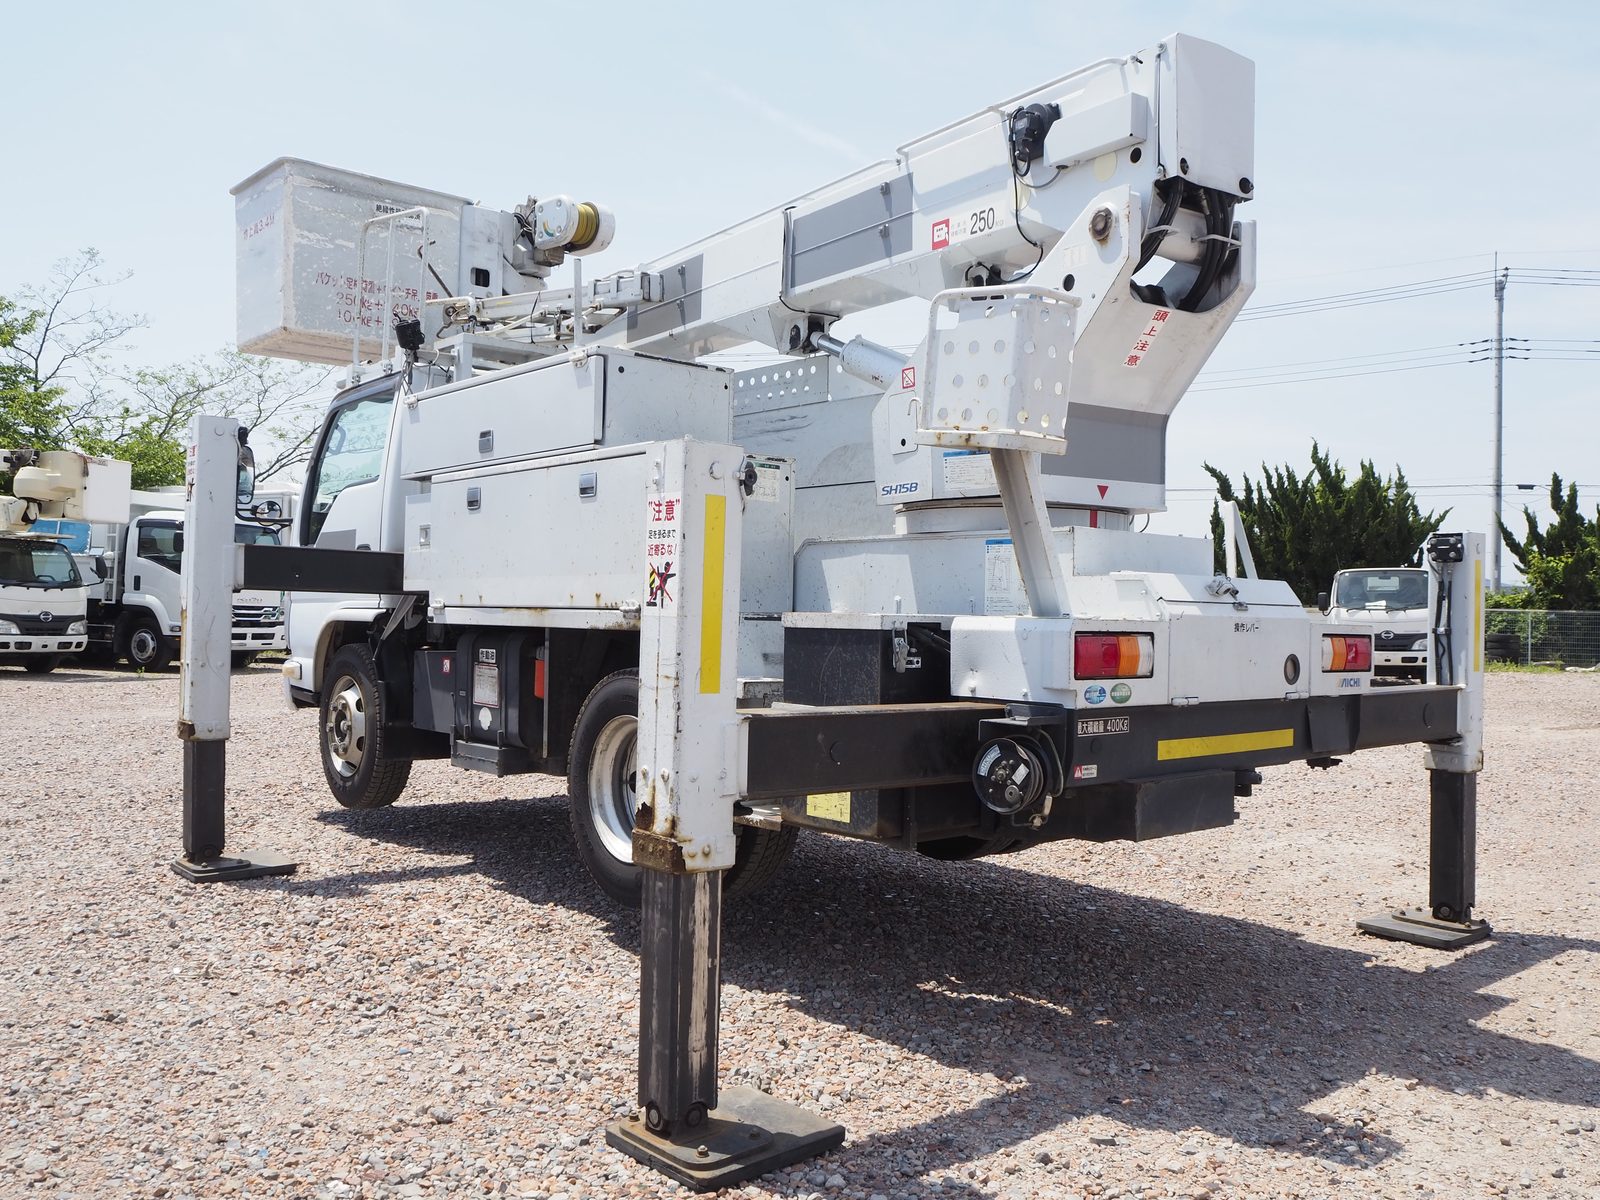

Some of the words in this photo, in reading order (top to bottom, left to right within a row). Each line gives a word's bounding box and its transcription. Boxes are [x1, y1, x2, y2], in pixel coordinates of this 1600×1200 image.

[970, 207, 995, 235] 250
[1123, 309, 1171, 367] 頭上注意
[881, 482, 918, 496] SH15B
[1339, 677, 1361, 688] AICHI
